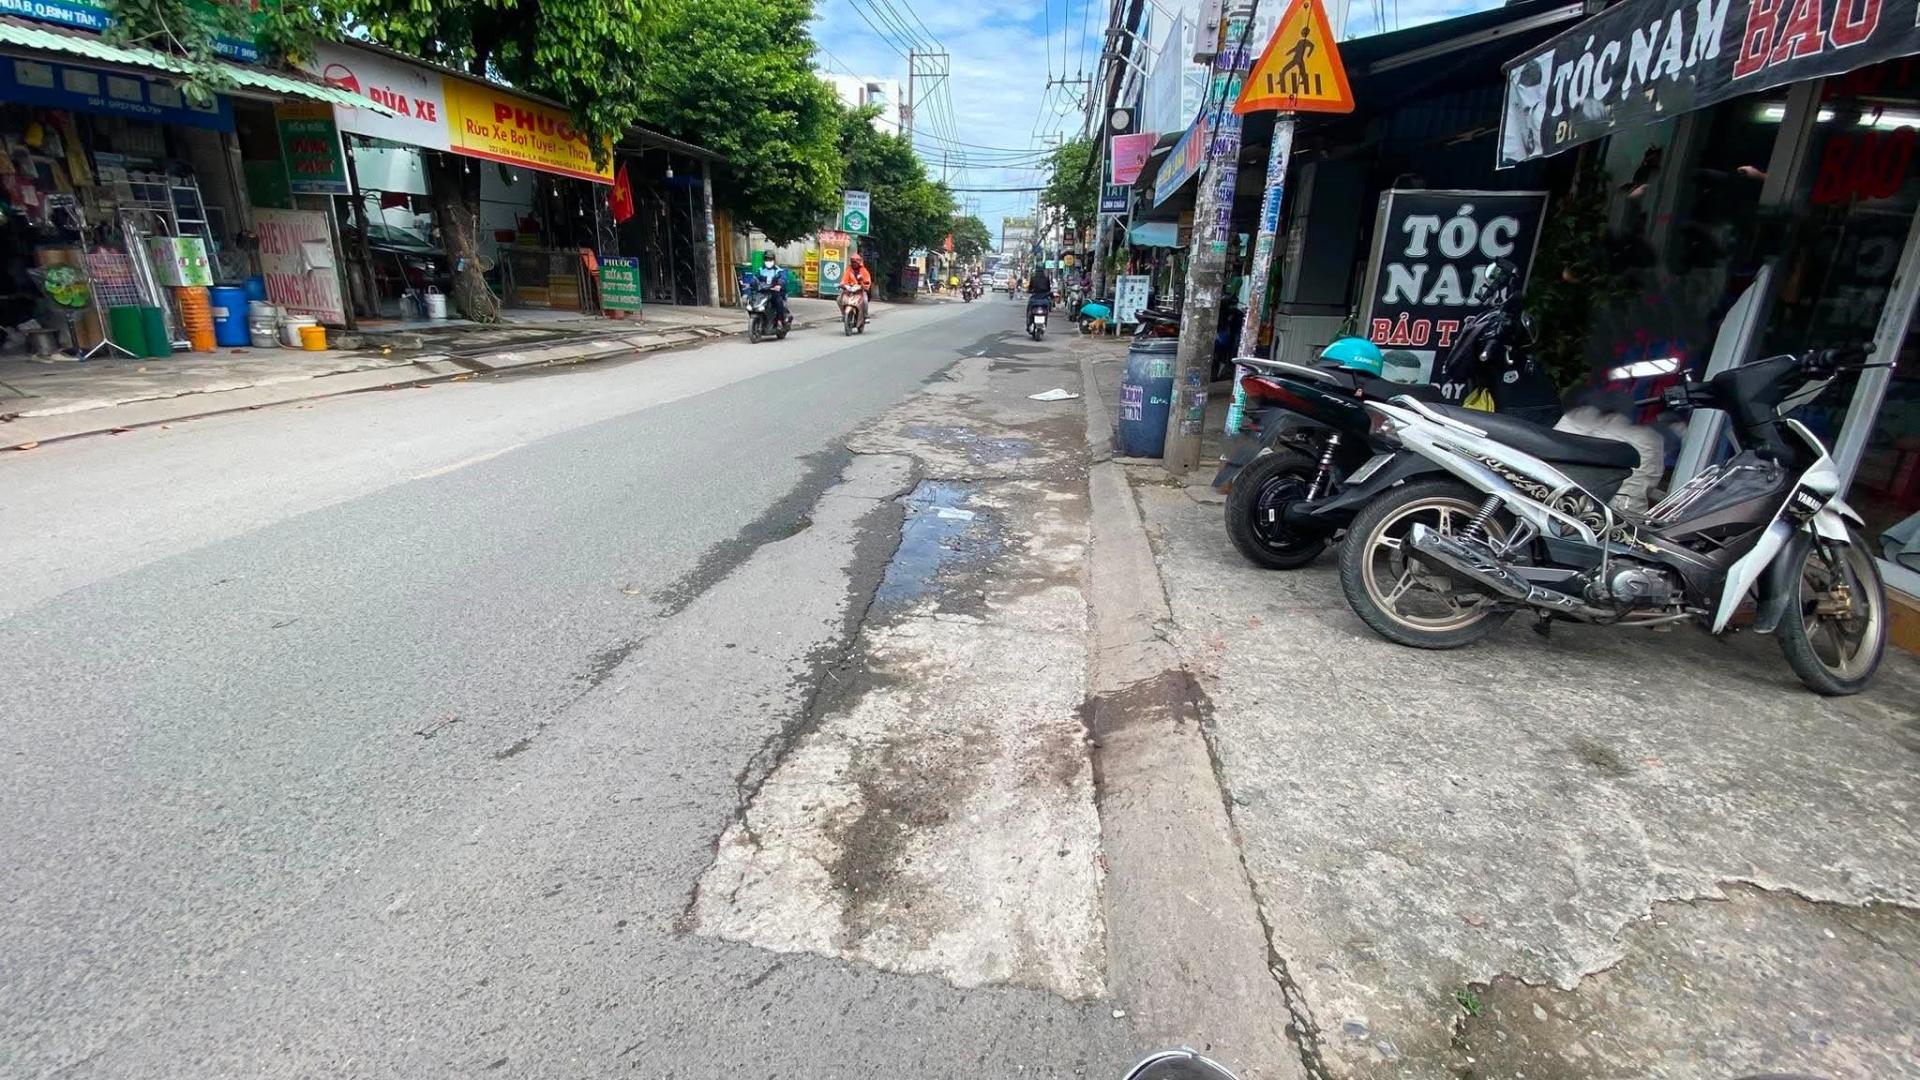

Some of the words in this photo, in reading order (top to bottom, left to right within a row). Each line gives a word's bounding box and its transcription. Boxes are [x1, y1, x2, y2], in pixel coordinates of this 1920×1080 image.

[1552, 34, 1621, 117] TÓC
[1622, 0, 1730, 100] NAM
[414, 98, 437, 122] XE
[492, 124, 507, 142] Xe
[568, 144, 589, 165] Thay
[1402, 203, 1520, 259] TÓC
[1370, 312, 1432, 346] BẢO
